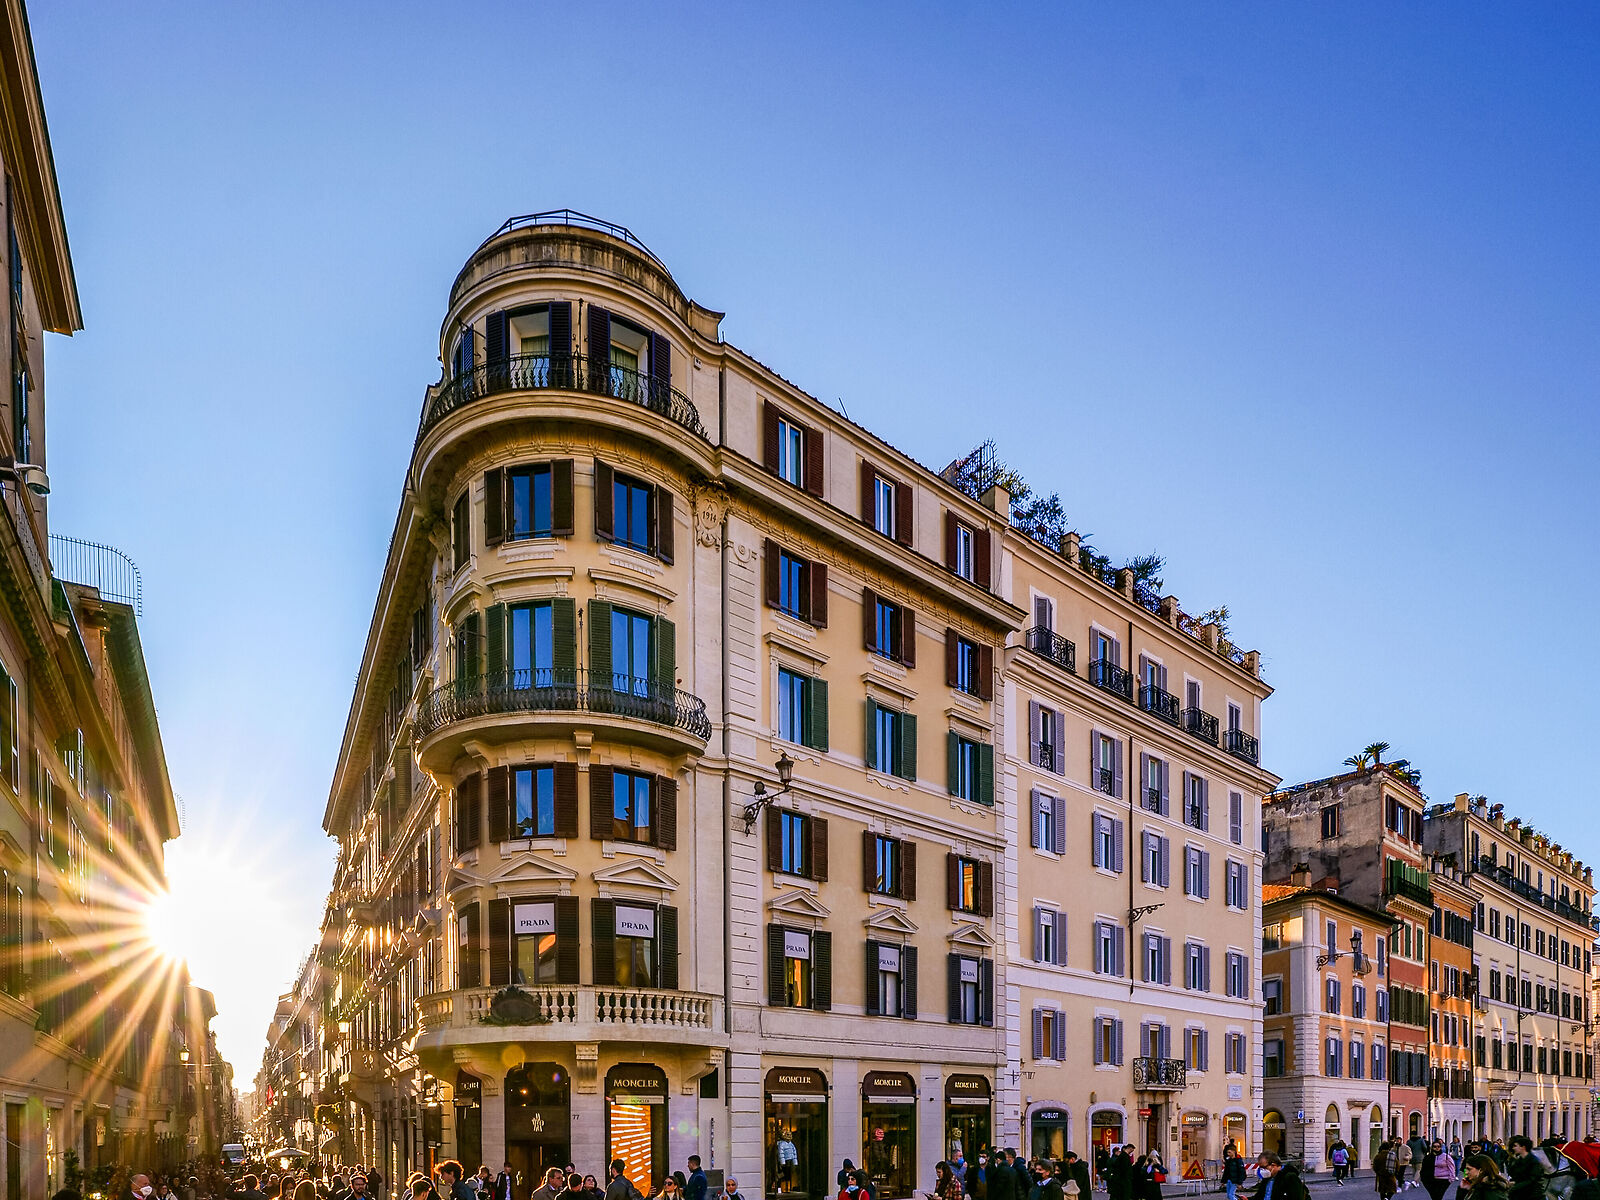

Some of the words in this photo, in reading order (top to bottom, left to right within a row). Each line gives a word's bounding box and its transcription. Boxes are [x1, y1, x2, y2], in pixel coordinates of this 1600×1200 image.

[702, 511, 717, 523] 1914
[520, 919, 550, 927] PRADA
[621, 921, 650, 931] PRADA
[786, 944, 806, 953] PRADA
[879, 958, 897, 967] PRADA
[613, 1079, 659, 1088] MONCLER
[778, 1075, 811, 1084] MONCLER
